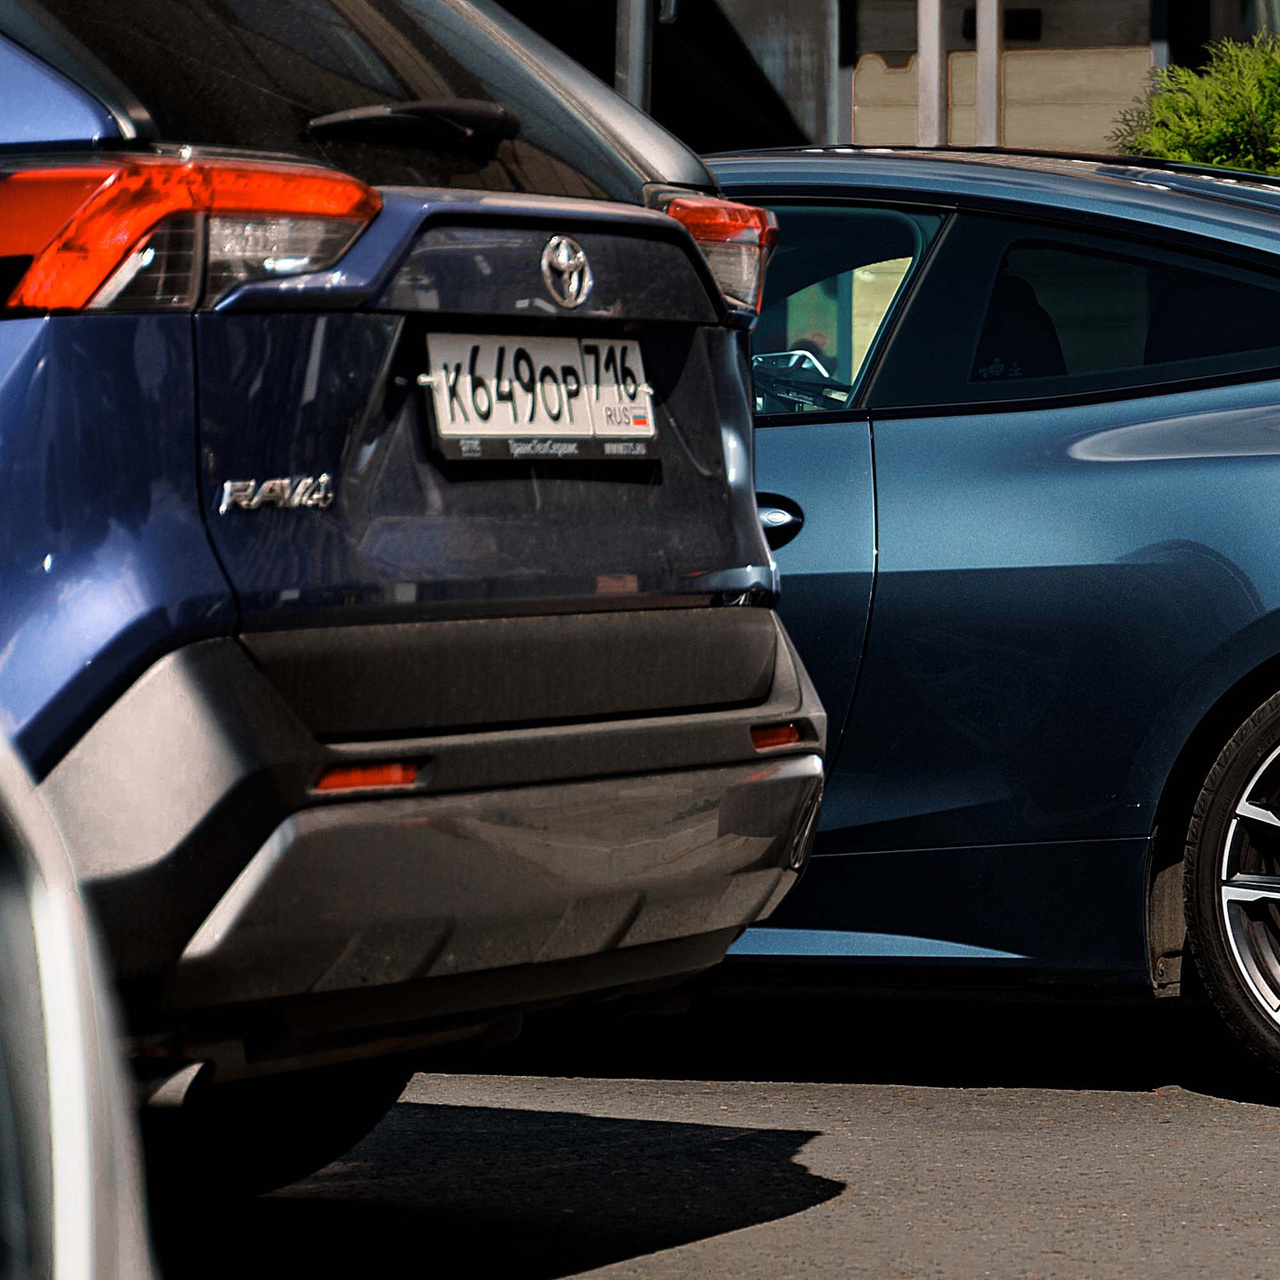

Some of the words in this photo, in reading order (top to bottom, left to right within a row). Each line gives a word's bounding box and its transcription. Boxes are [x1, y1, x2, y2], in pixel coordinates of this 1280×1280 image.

[583, 344, 638, 404] 716
[604, 406, 631, 426] RUS
[219, 472, 334, 515] RAV4
